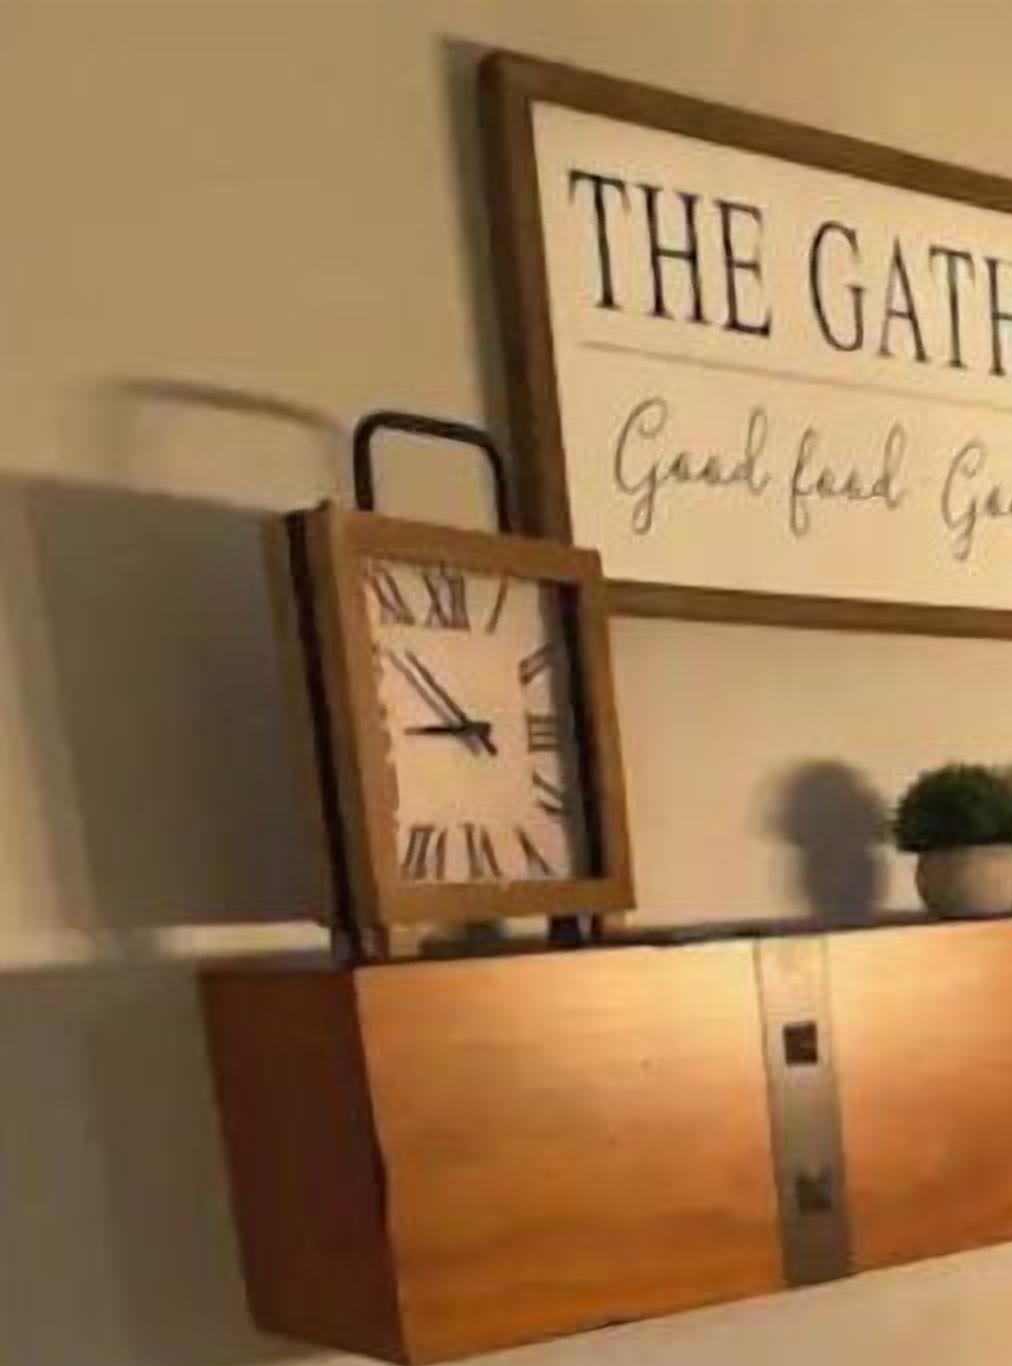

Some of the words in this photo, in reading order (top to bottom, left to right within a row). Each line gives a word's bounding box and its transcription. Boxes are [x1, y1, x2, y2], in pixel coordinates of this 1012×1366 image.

[568, 169, 772, 338] THE
[613, 396, 771, 535] Good
[788, 420, 907, 536] food
